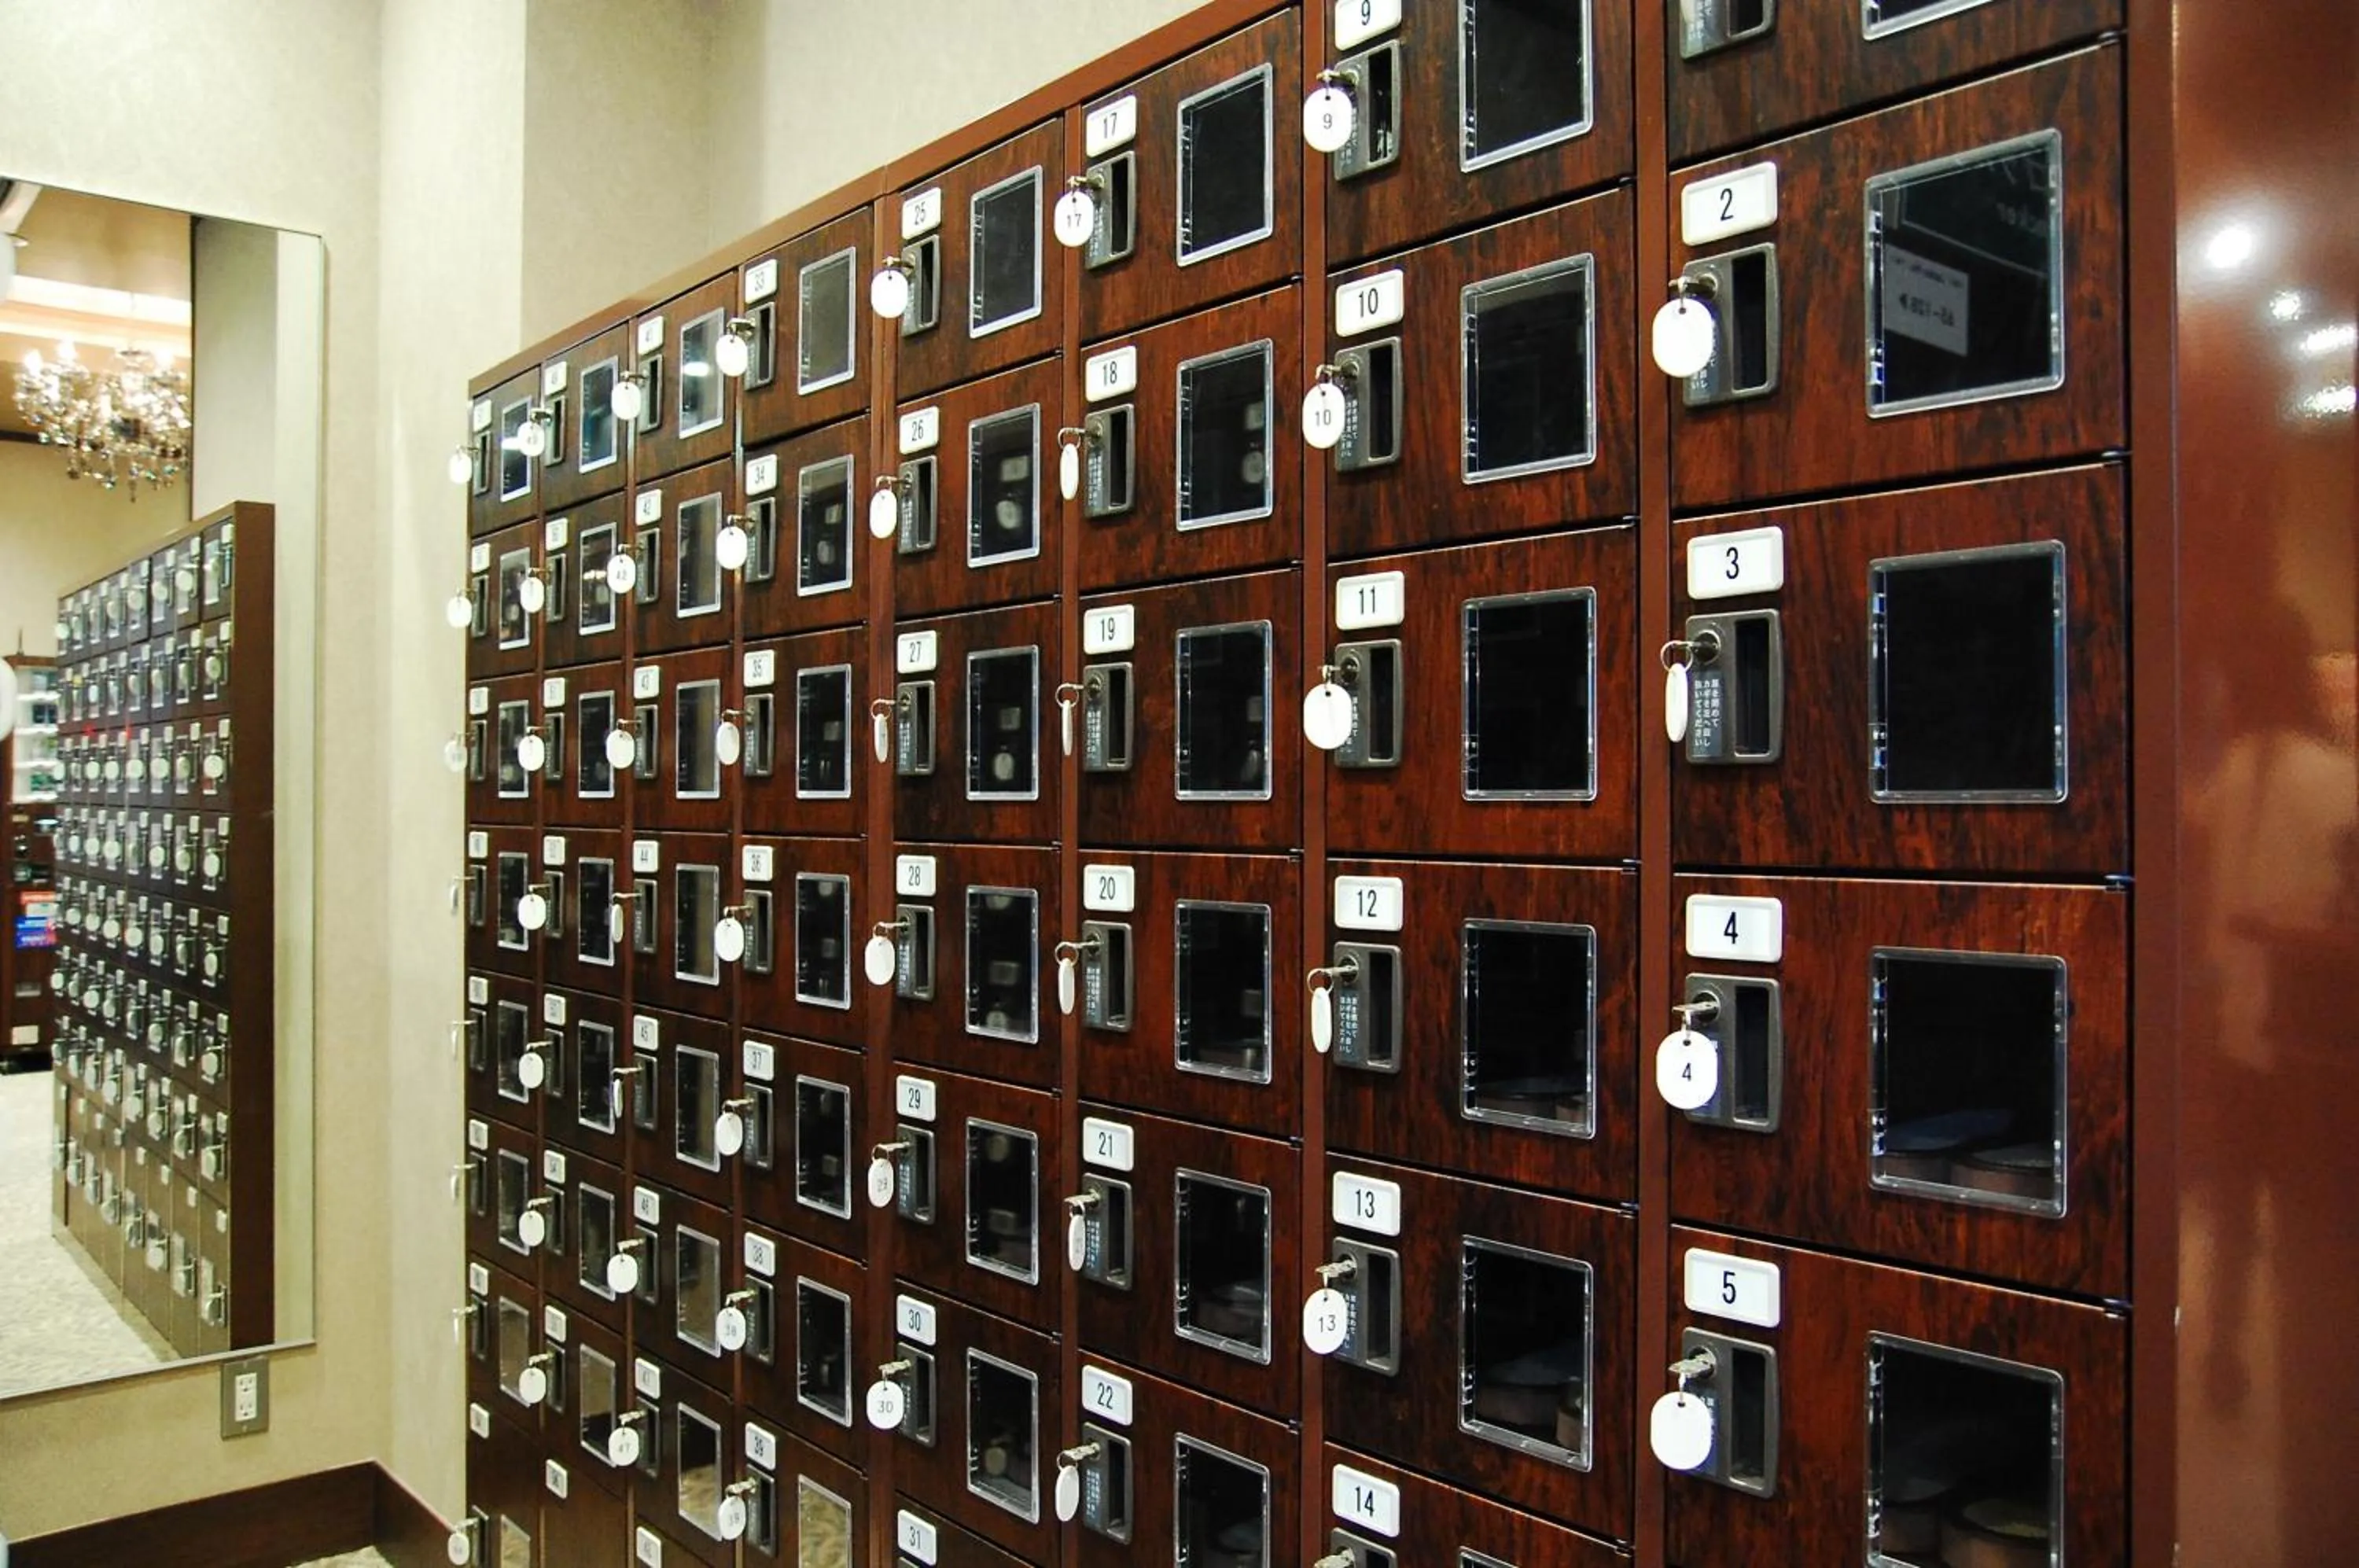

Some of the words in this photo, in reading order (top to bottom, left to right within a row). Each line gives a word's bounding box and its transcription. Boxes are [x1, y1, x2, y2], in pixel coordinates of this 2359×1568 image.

[1362, 0, 1370, 25] 9
[1102, 111, 1118, 141] 17
[1323, 113, 1332, 129] 9
[913, 201, 927, 227] 25
[1720, 188, 1734, 222] 2
[1066, 213, 1083, 229] 17
[1358, 287, 1378, 317] 10
[1102, 360, 1117, 385] 18
[1315, 408, 1331, 426] 10
[911, 419, 924, 442] 26
[753, 465, 766, 485] 34
[1725, 547, 1740, 580] 3
[1358, 587, 1375, 614] 11
[1101, 617, 1115, 642] 19
[909, 641, 922, 663] 27
[908, 865, 921, 887] 28
[1099, 875, 1116, 900] 20
[1357, 889, 1377, 918] 12
[1723, 911, 1739, 944] 4
[1682, 1063, 1691, 1080] 4
[908, 1088, 921, 1110] 29
[1099, 1132, 1113, 1157] 21
[1356, 1189, 1375, 1219] 13
[1722, 1270, 1736, 1305] 5
[908, 1309, 921, 1332] 30
[1319, 1314, 1336, 1333] 13
[878, 1400, 894, 1414] 30
[1097, 1382, 1113, 1410] 22
[1355, 1486, 1375, 1517] 14
[908, 1525, 922, 1551] 31
